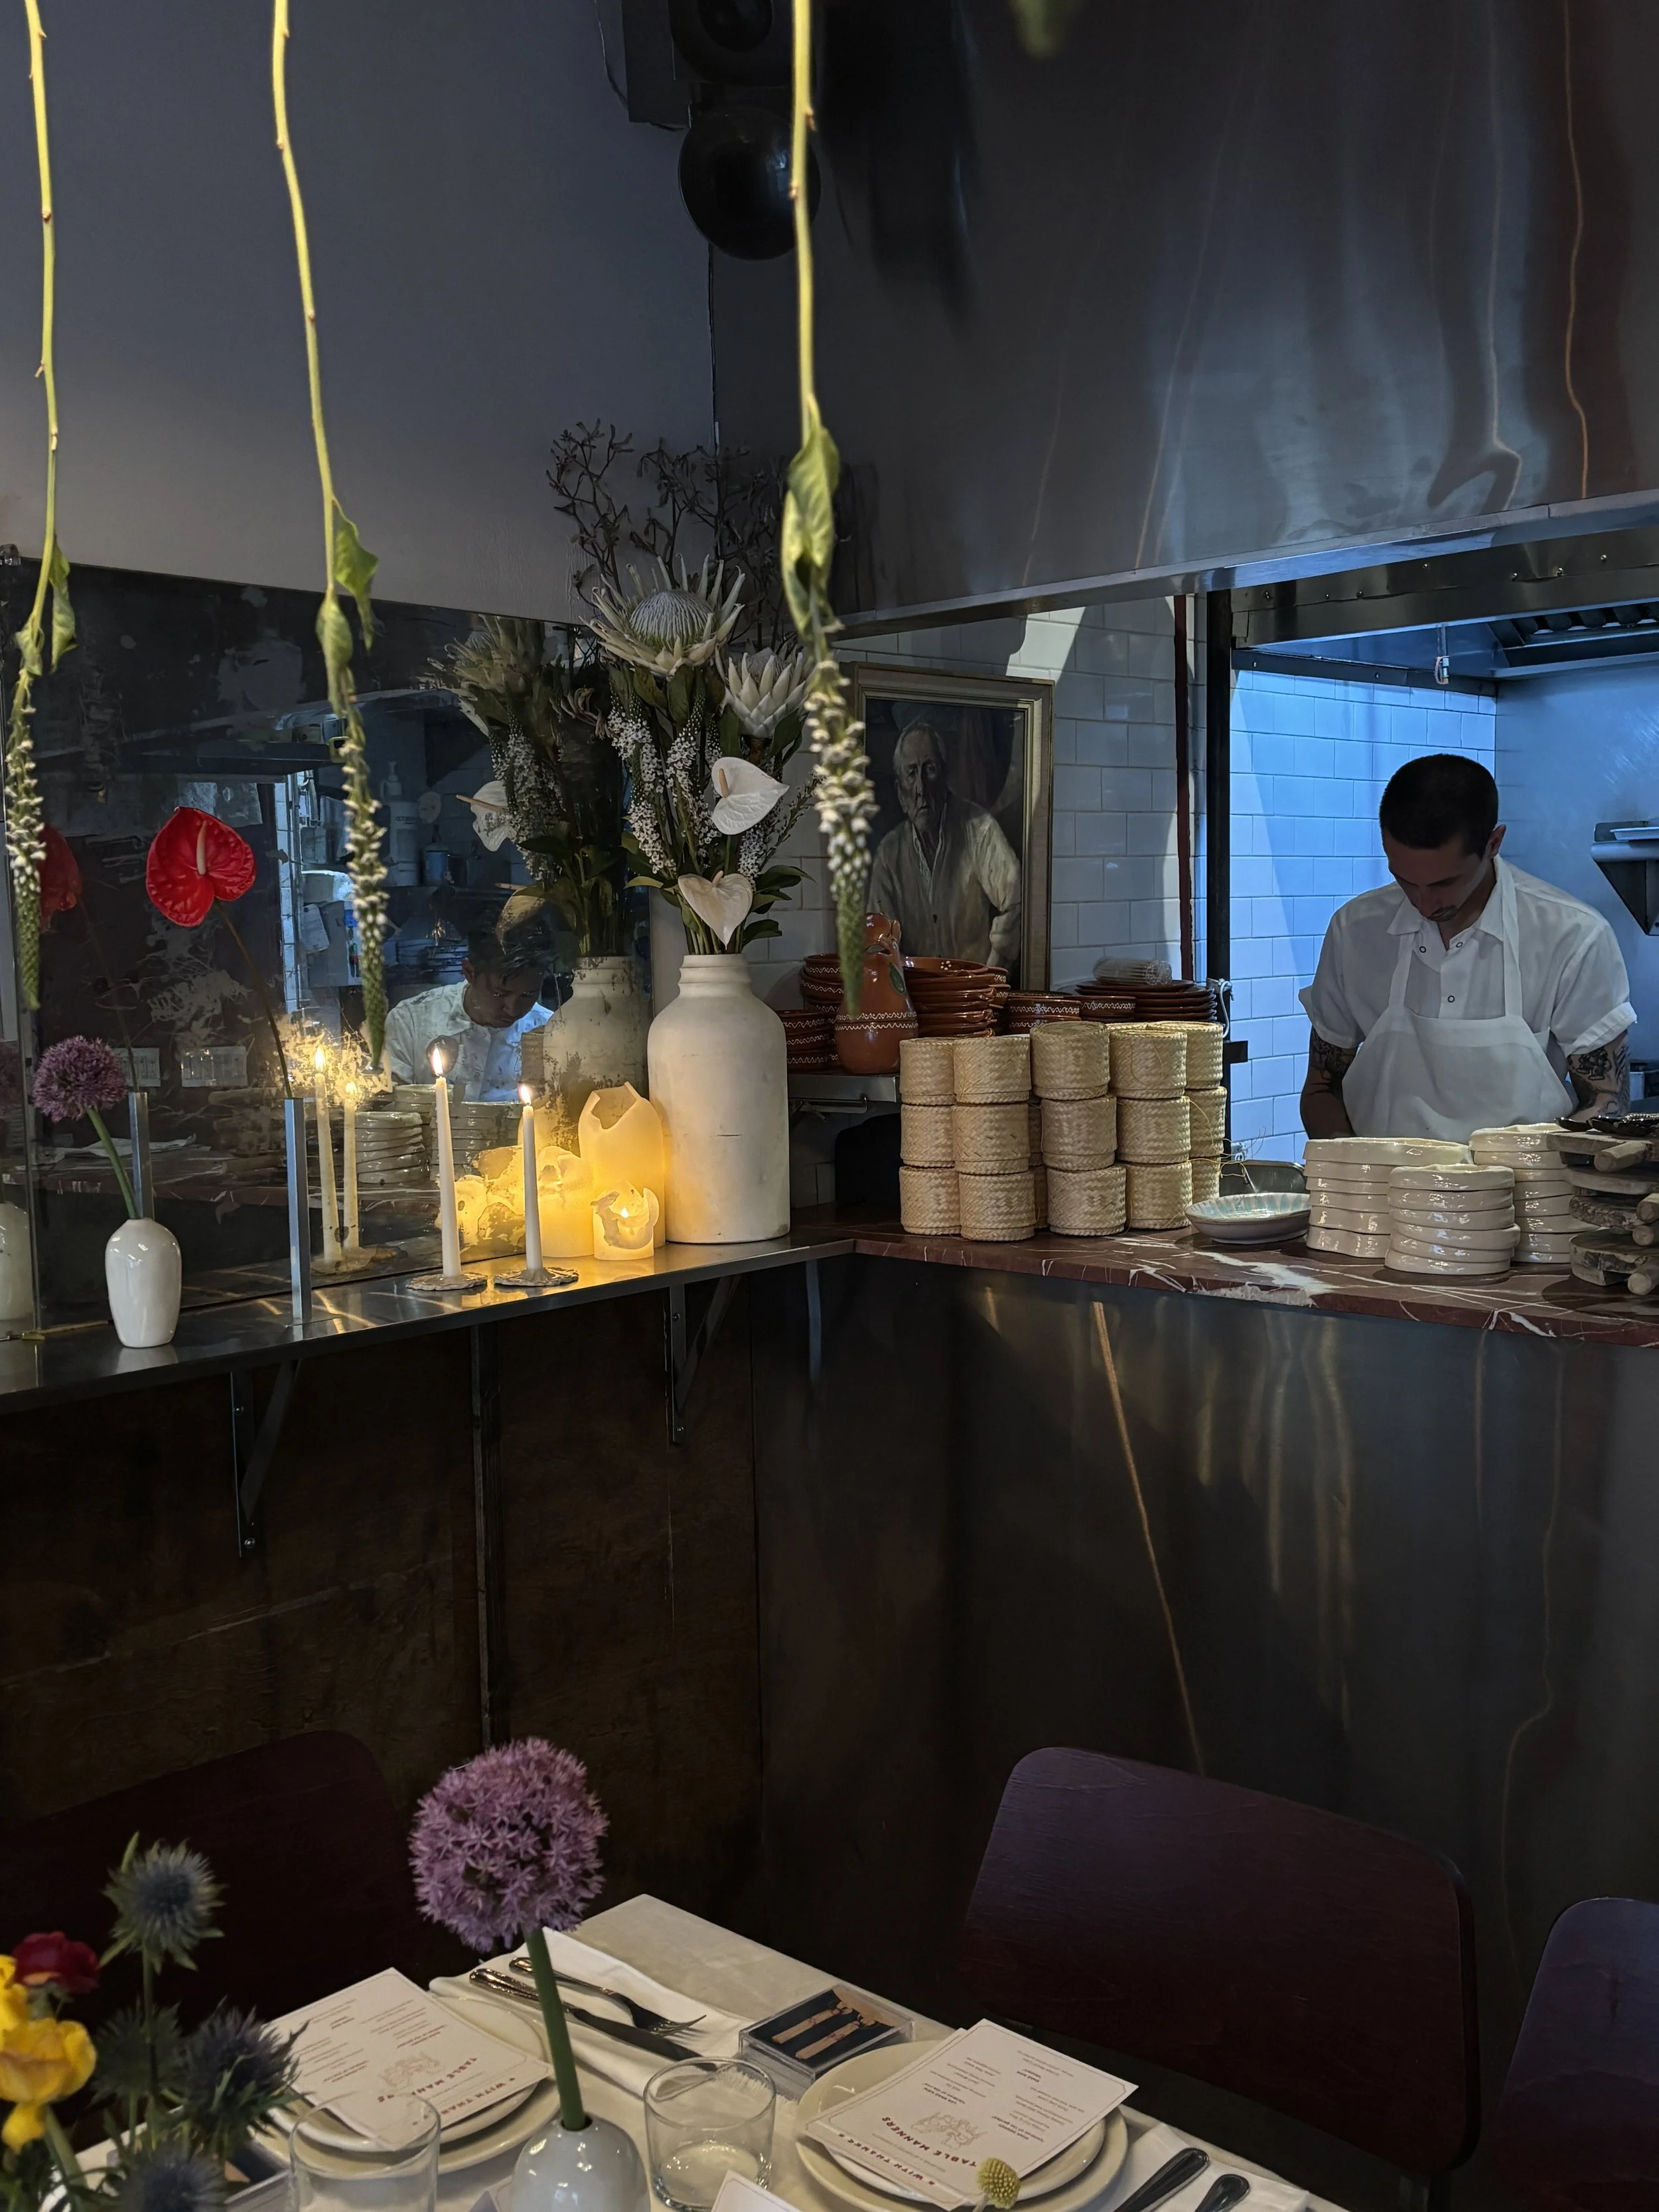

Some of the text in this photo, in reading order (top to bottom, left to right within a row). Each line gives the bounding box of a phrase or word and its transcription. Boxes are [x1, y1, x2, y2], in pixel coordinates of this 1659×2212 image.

[446, 2057, 477, 2079] TABLE
[474, 2082, 506, 2098] WITH
[881, 2116, 931, 2151] MANNERS
[847, 2139, 891, 2164] THANKS
[933, 2150, 977, 2168] TABLE
[894, 2163, 923, 2180] WITH
